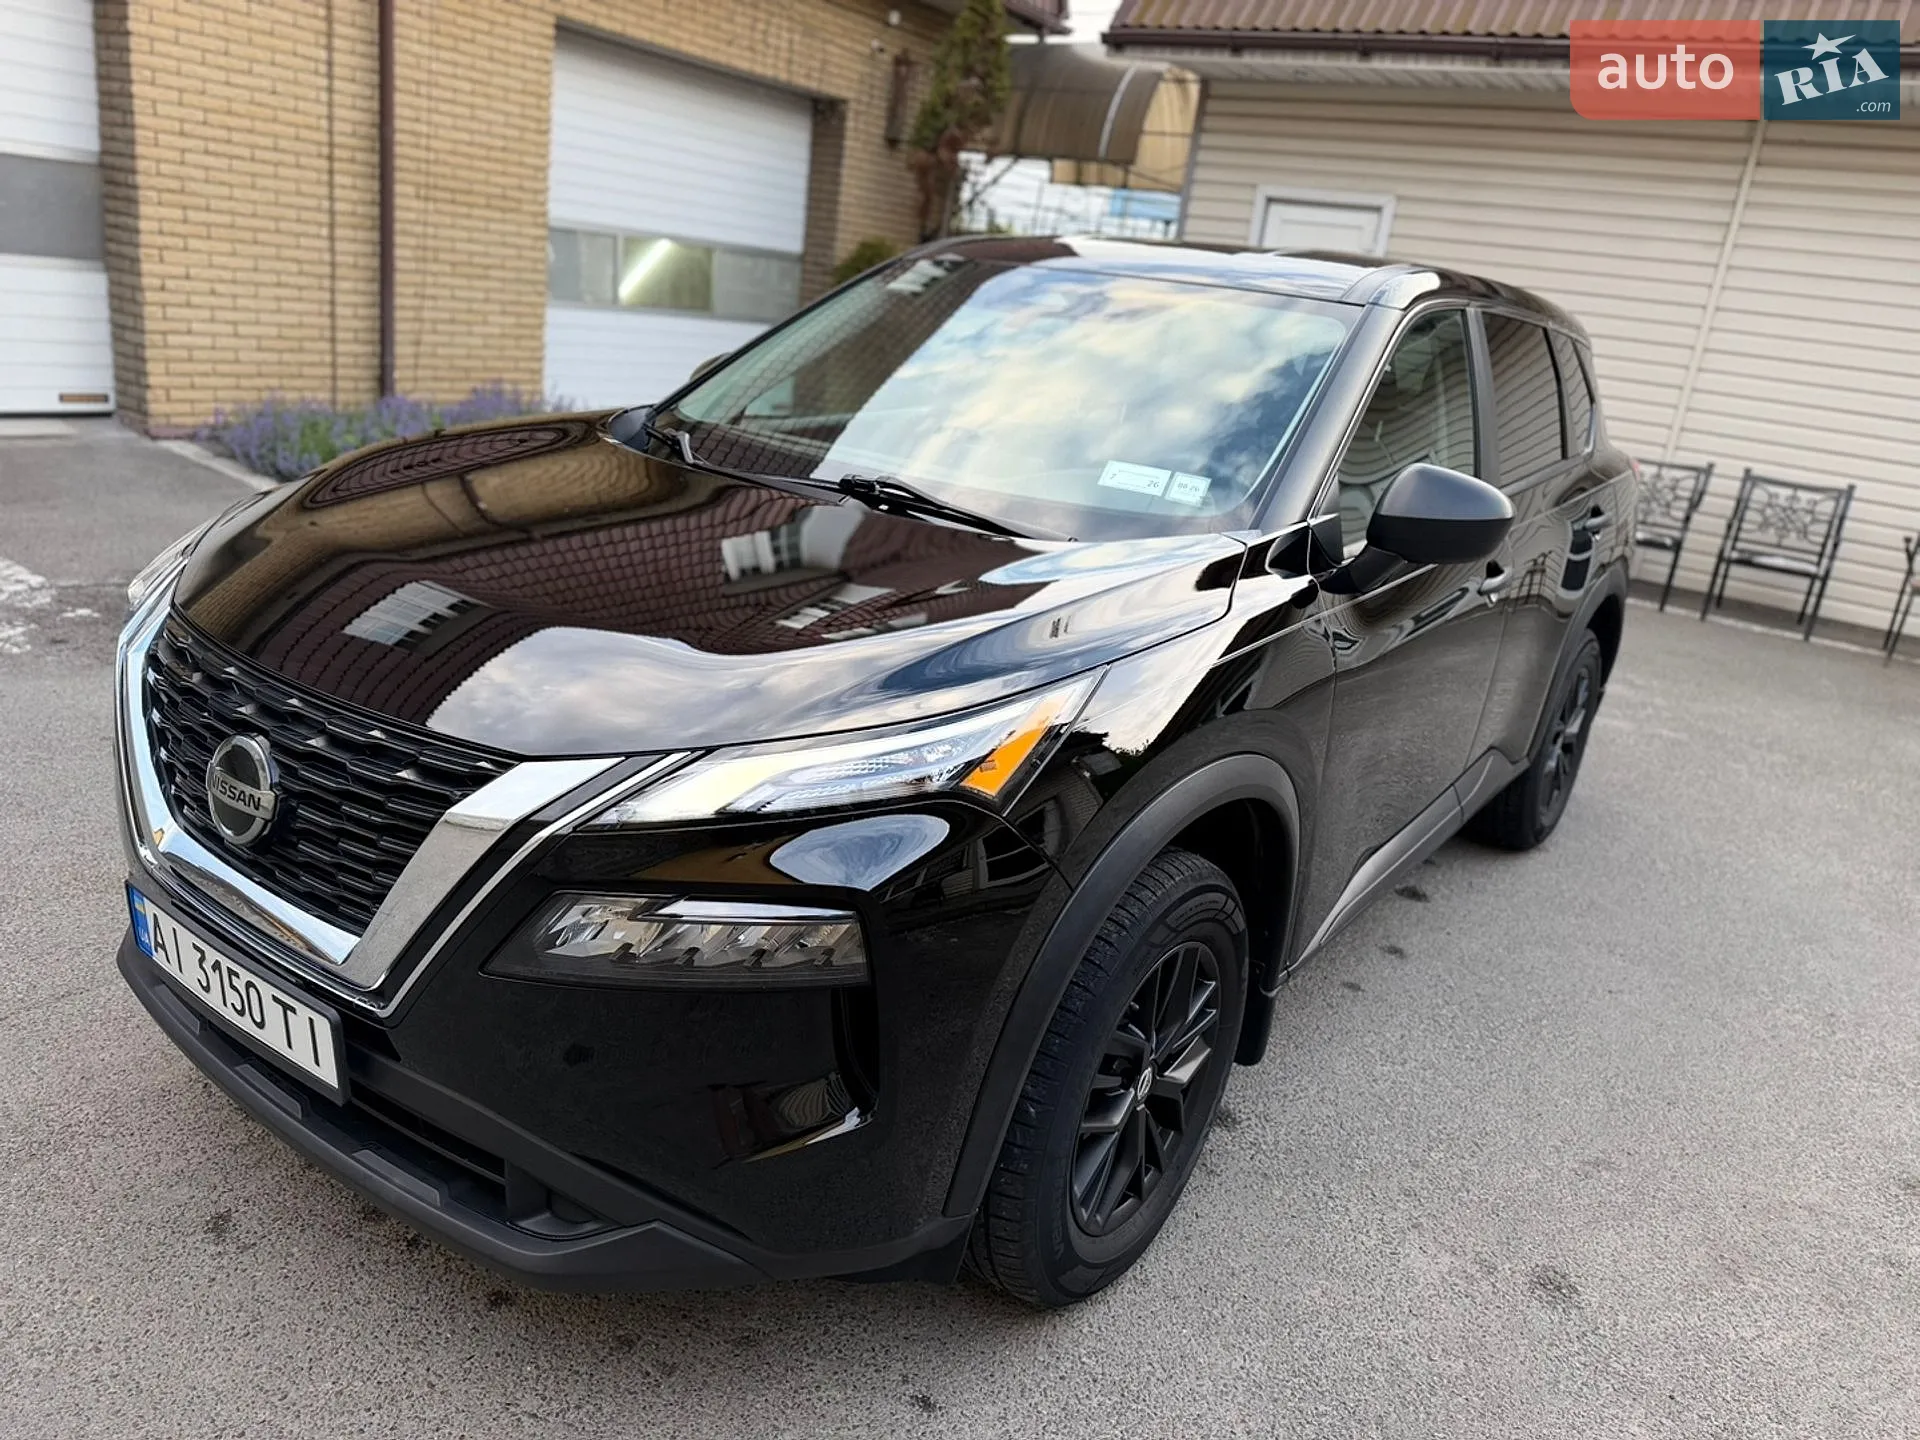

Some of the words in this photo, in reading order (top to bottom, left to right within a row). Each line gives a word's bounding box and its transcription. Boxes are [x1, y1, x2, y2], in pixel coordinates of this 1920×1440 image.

[213, 773, 261, 811] NISSAN
[153, 912, 184, 975] AI
[192, 942, 266, 1030] 3150
